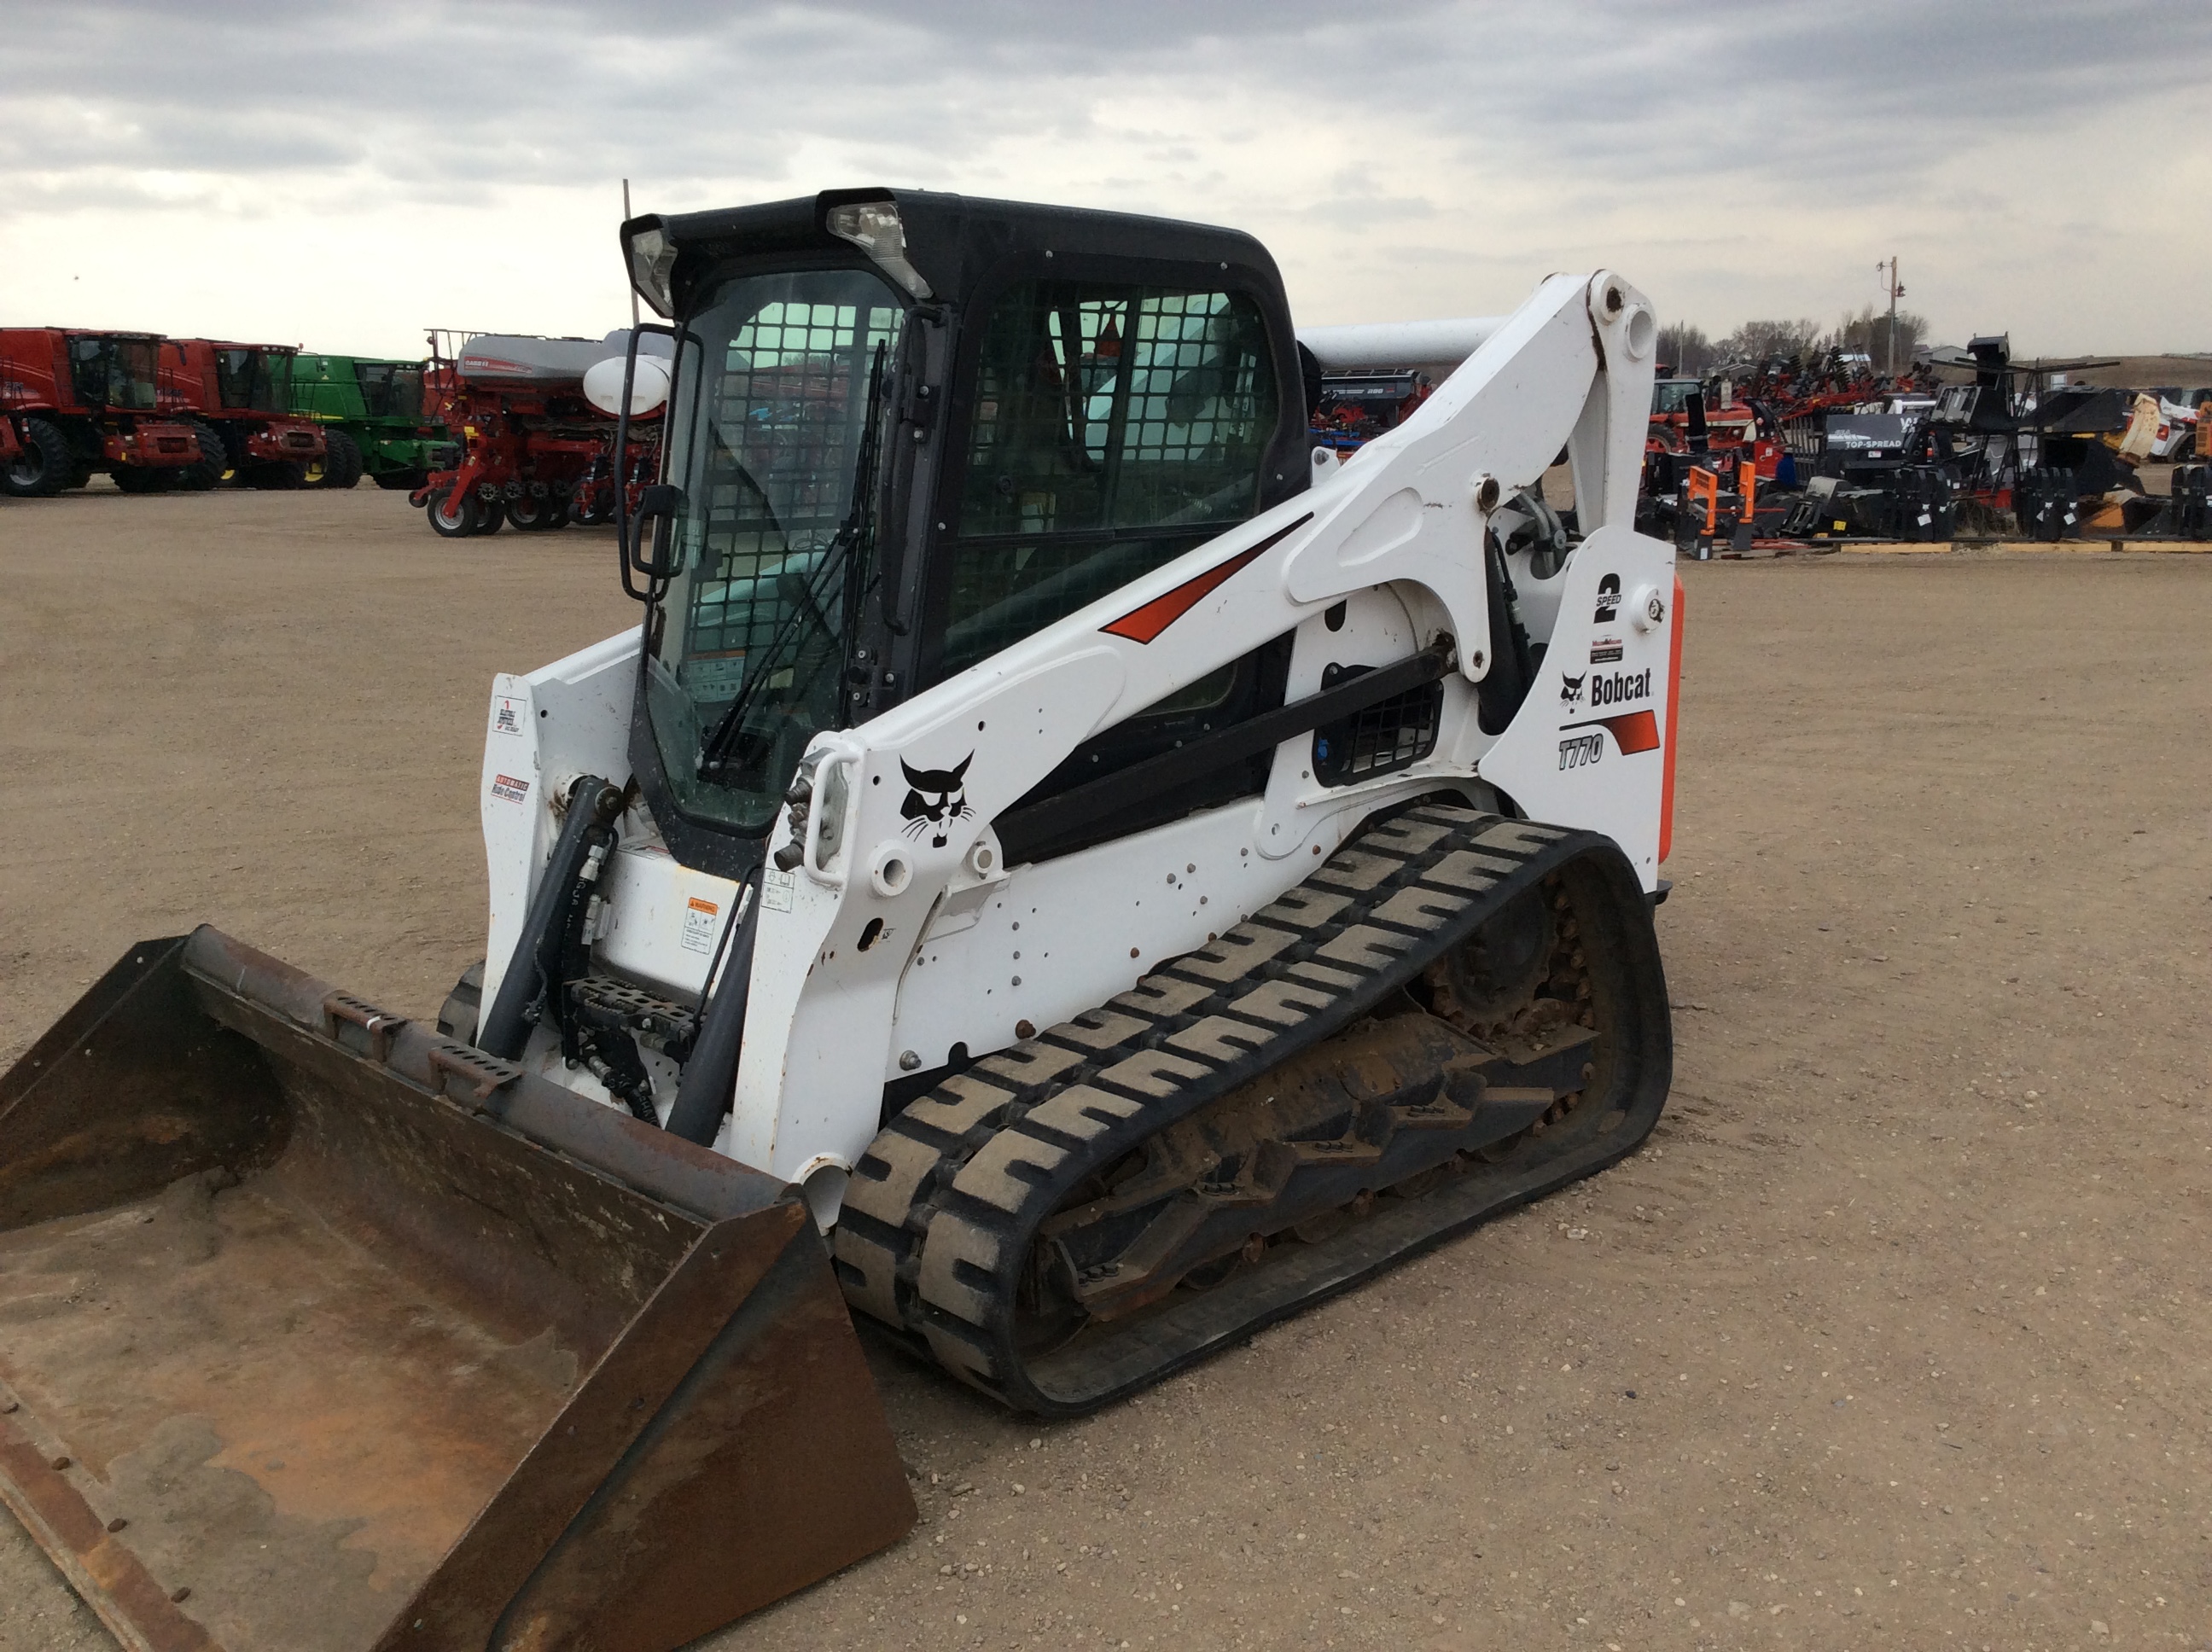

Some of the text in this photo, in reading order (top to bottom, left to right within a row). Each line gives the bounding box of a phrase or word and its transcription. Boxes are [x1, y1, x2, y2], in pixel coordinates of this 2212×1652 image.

[1846, 440, 1901, 449] TOP-SPREAD
[1593, 573, 1621, 624] 2
[1596, 594, 1622, 607] SPEED
[1592, 667, 1650, 707] Bobcat
[1559, 733, 1604, 771] T770
[496, 776, 527, 790] AUTOMATIC
